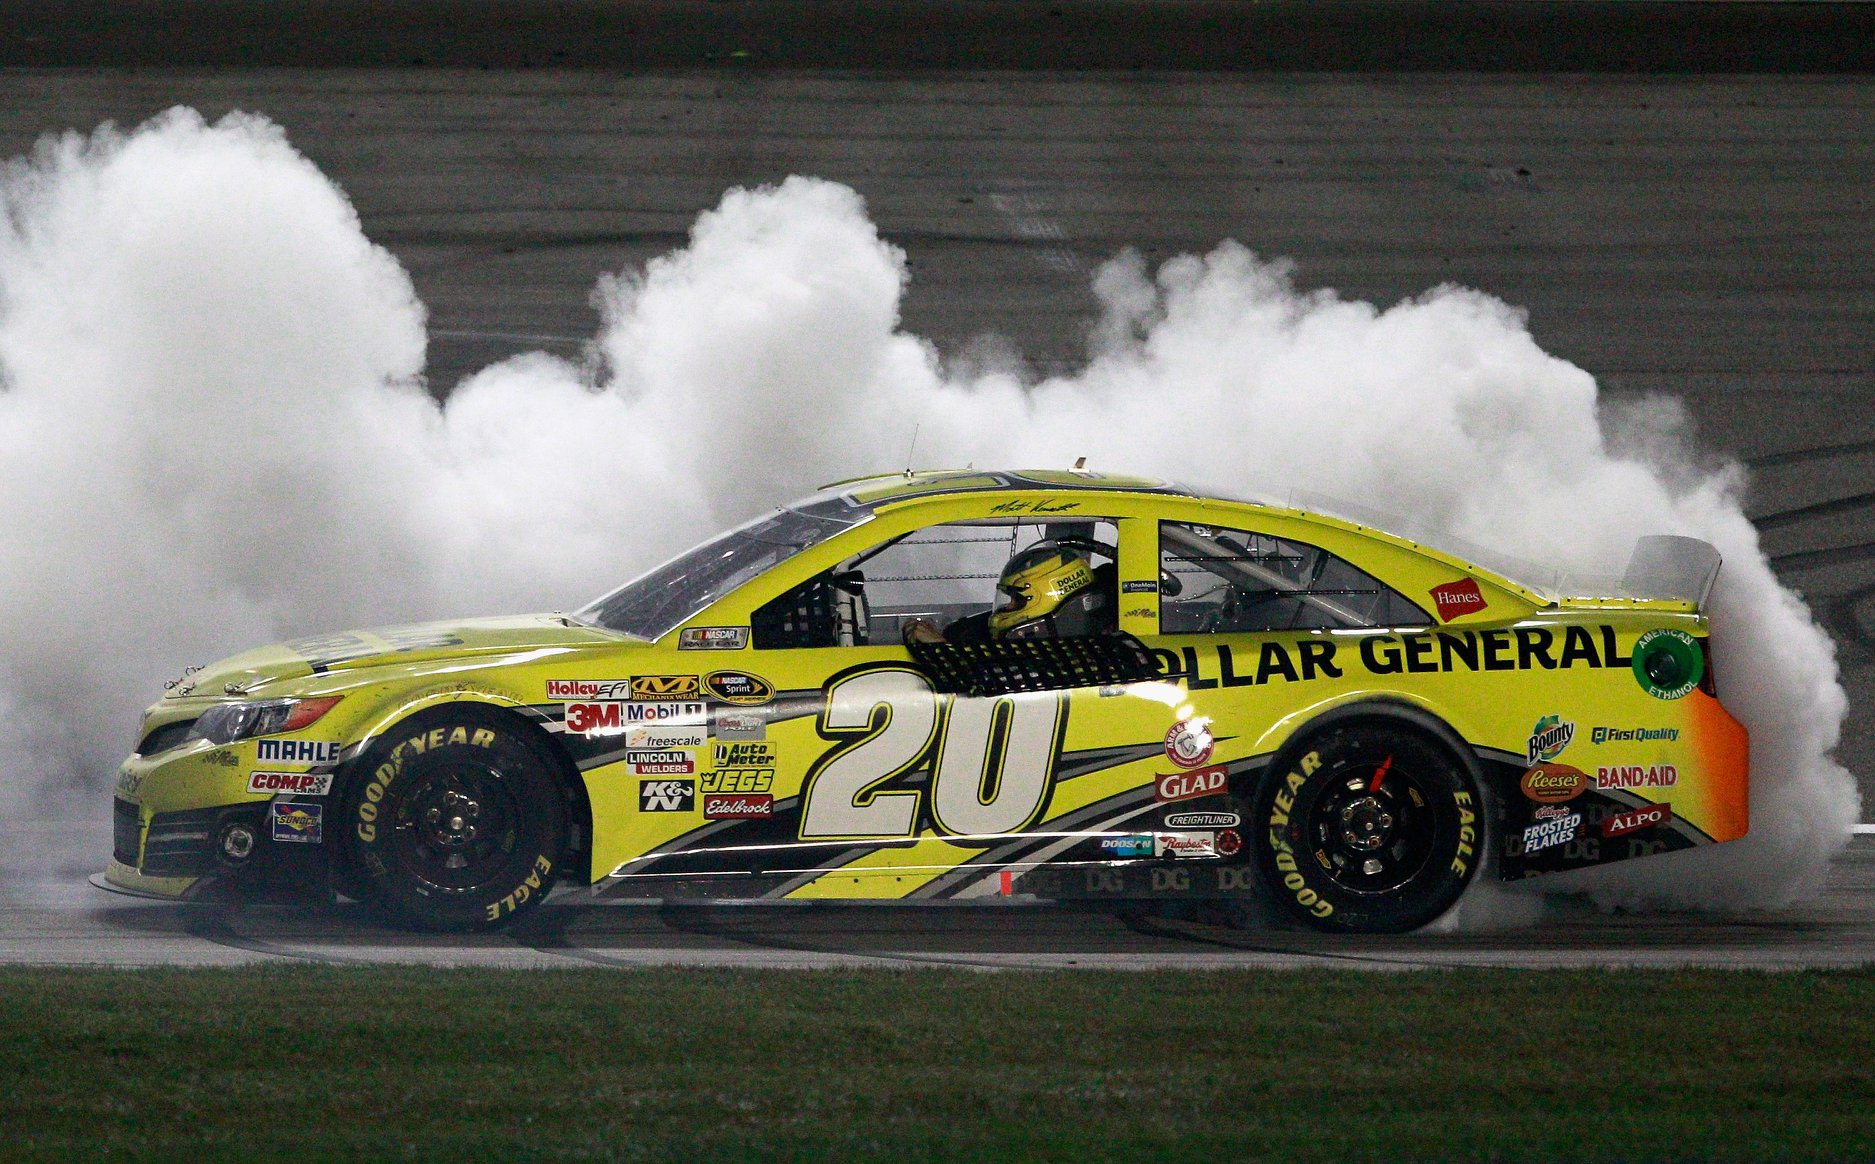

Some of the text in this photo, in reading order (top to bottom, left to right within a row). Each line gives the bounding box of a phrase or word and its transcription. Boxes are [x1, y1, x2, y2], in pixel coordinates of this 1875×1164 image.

[1057, 569, 1087, 587] DOLLAR
[1437, 590, 1480, 604] Hanes
[705, 630, 736, 639] NASCAR
[1638, 629, 1694, 649] AMERICAN
[1360, 625, 1634, 676] GENERAL
[548, 682, 627, 699] Holley EFI
[633, 692, 699, 700] MECHANIX WEAR
[726, 685, 751, 694] Sprint
[1648, 681, 1698, 699] ETHANOL
[567, 703, 620, 732] 3M
[628, 704, 680, 720] Mobil
[647, 736, 702, 746] freescale
[1608, 727, 1680, 742] First Quality
[257, 740, 341, 761] MAHLE
[731, 744, 767, 754] Auto
[1528, 721, 1575, 766] Bounty
[630, 753, 682, 763] LINCOLN
[727, 754, 775, 766] Meter
[799, 667, 1064, 840] 20
[641, 765, 688, 773] WELDERS
[252, 774, 315, 789] COMP
[700, 769, 775, 793] JEGS
[1160, 771, 1226, 798] GLAD
[706, 799, 771, 814] Edelbrock
[278, 815, 318, 826] SUNOCO
[1172, 815, 1234, 825] FREIGHTLINER
[1523, 814, 1581, 842] FROSTED
[1609, 810, 1662, 832] ALPO
[1451, 791, 1476, 879] EAGLE
[1524, 828, 1575, 853] FLAKES
[1151, 866, 1190, 891] DG
[485, 854, 552, 922] EAGLE
